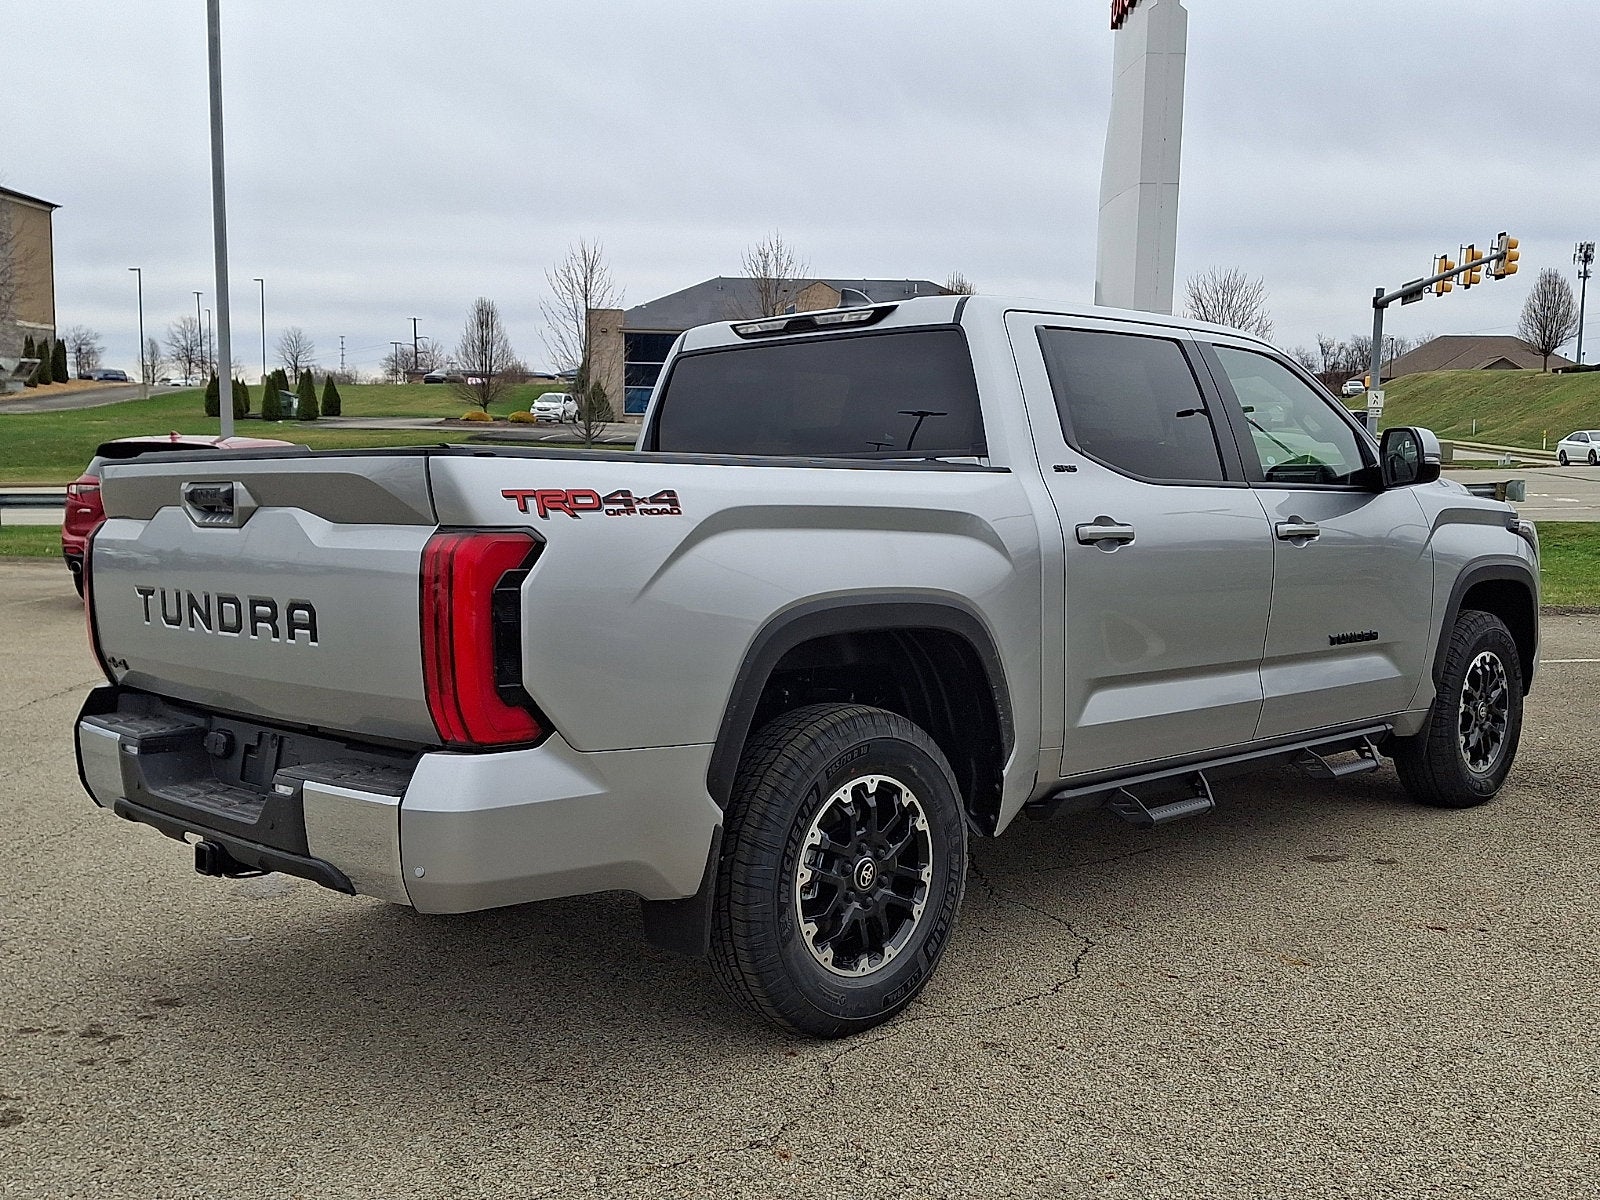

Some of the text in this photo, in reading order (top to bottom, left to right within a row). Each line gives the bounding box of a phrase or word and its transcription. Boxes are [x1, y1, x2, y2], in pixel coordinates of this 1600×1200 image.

[501, 489, 603, 519] TRD
[604, 508, 682, 517] OFF ROAD
[134, 585, 319, 646] TUNDRA
[779, 788, 819, 904] MICHELIN
[926, 854, 961, 958] MICHELIN
